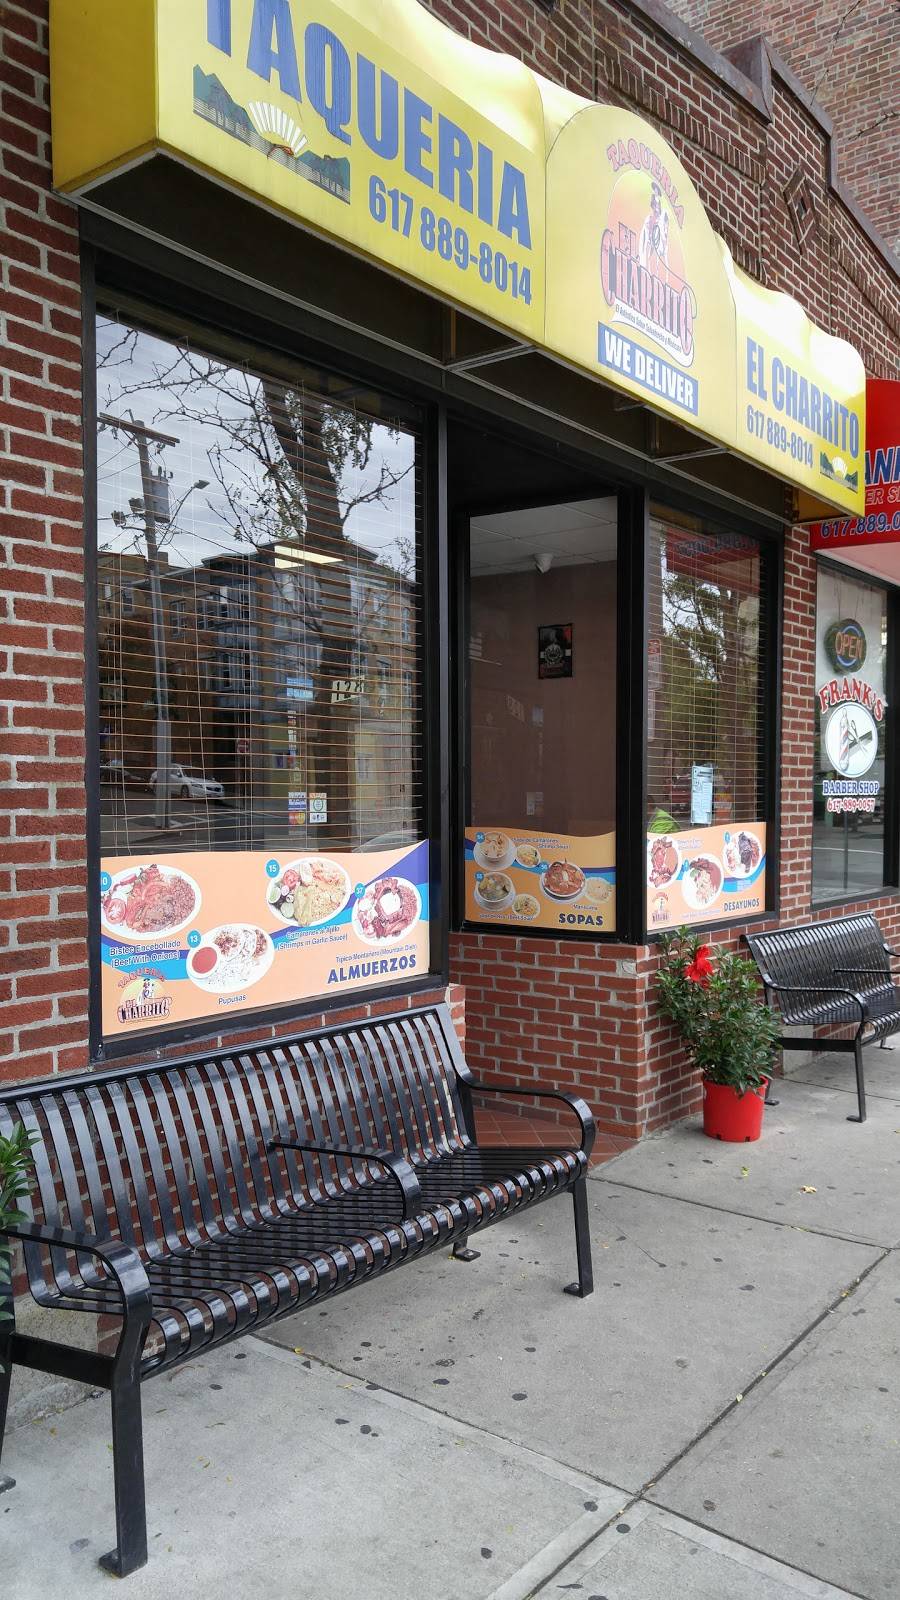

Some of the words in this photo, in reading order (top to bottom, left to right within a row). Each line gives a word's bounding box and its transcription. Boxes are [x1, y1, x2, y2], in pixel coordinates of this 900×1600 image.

[206, 0, 532, 250] TAQUERIA
[606, 138, 684, 230] TAQUERIA
[369, 175, 413, 239] 617
[420, 207, 532, 305] 889-8014
[618, 221, 640, 259] EL
[600, 228, 697, 356] CHARRITO
[604, 329, 631, 374] WE
[635, 348, 694, 409] DELIVER
[746, 336, 768, 401] EL
[771, 356, 859, 459] CHARRITO
[746, 404, 765, 440] 617
[767, 417, 814, 468] 889-8014
[835, 631, 864, 660] OPEN
[819, 677, 885, 722] FRANK'S
[823, 781, 859, 796] BARBER
[859, 780, 880, 795] SHOP
[826, 797, 876, 814] 617-889-0057
[268, 864, 277, 873] 15
[723, 898, 760, 912] DESAYUNOS
[558, 913, 604, 927] SOPAS
[110, 946, 135, 956] Bistec
[135, 940, 181, 953] Encebollado
[190, 935, 198, 943] 13
[132, 955, 150, 964] With
[327, 954, 417, 984] ALMUERZOS
[118, 967, 166, 988] TAQUERIA
[117, 997, 173, 1024] CHARRITO
[218, 994, 247, 1005] Pupusas
